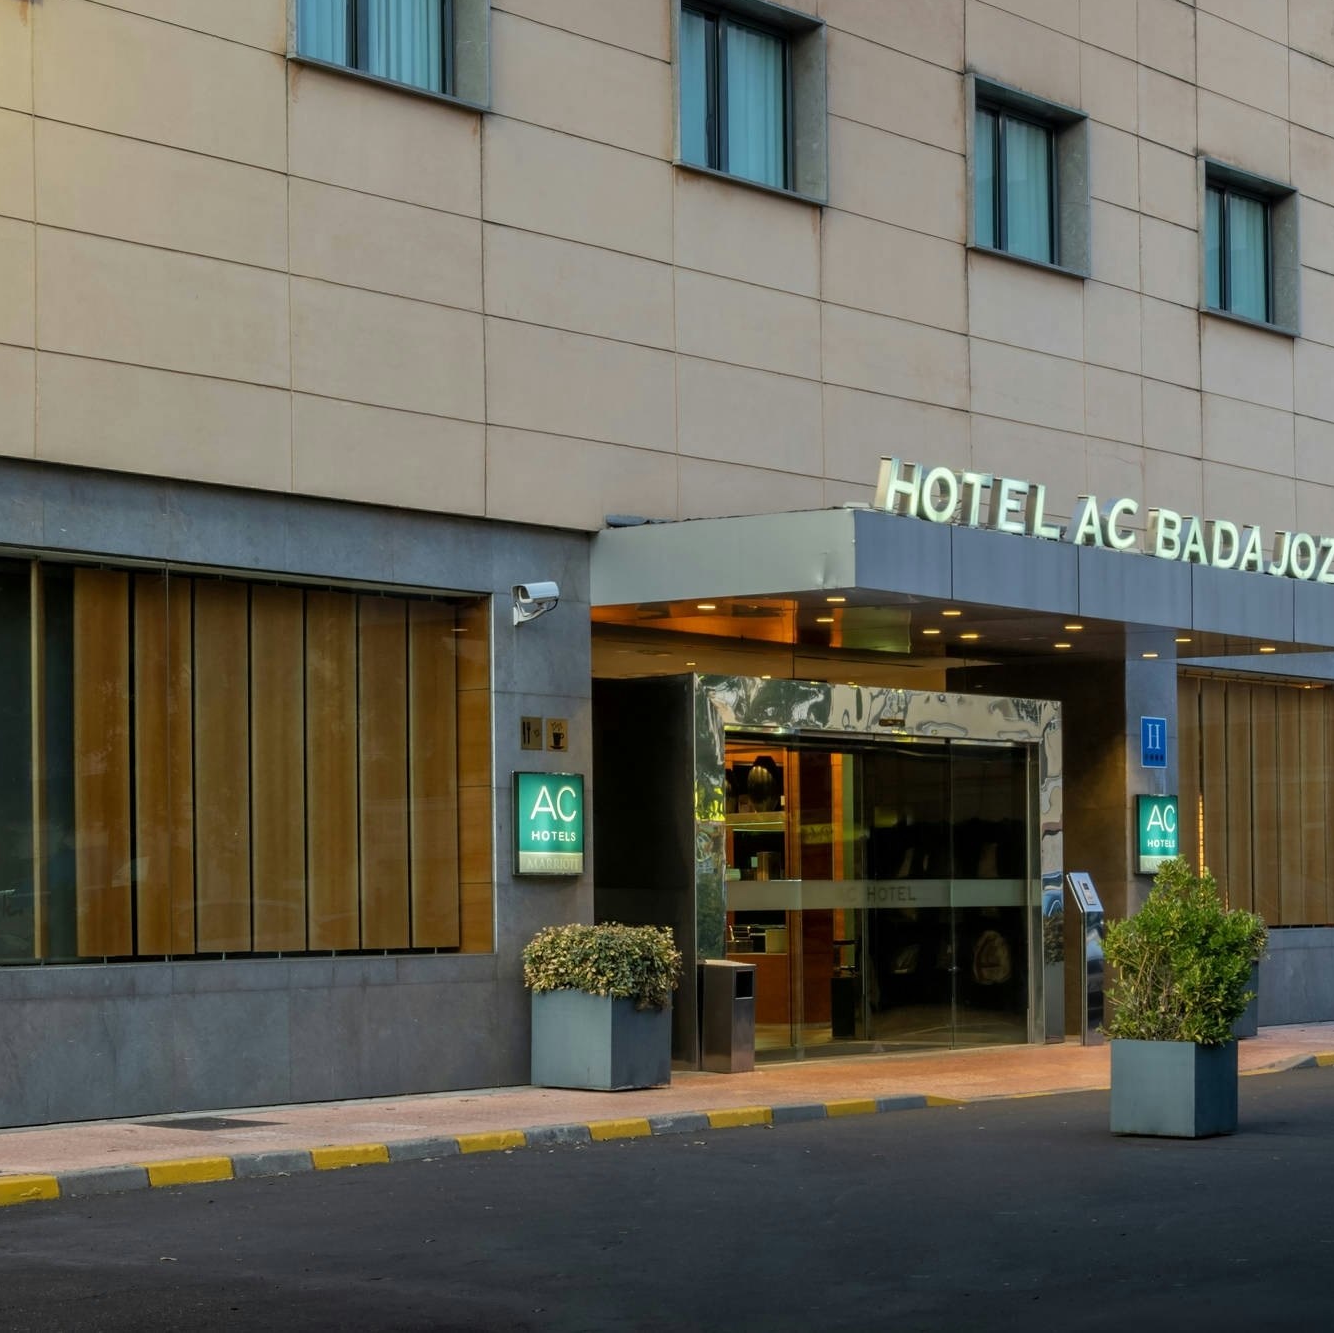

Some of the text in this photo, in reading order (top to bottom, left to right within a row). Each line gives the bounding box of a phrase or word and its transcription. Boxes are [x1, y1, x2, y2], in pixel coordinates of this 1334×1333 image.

[876, 456, 1061, 540] HOTEL
[1073, 495, 1139, 550] AC
[1147, 723, 1161, 749] H
[530, 785, 577, 822] AC
[1146, 804, 1176, 832] AC
[531, 830, 576, 841] HOTELS
[1147, 839, 1175, 848] HOTELS
[527, 858, 580, 870] MARRIOTT
[867, 885, 917, 901] HOTEL
